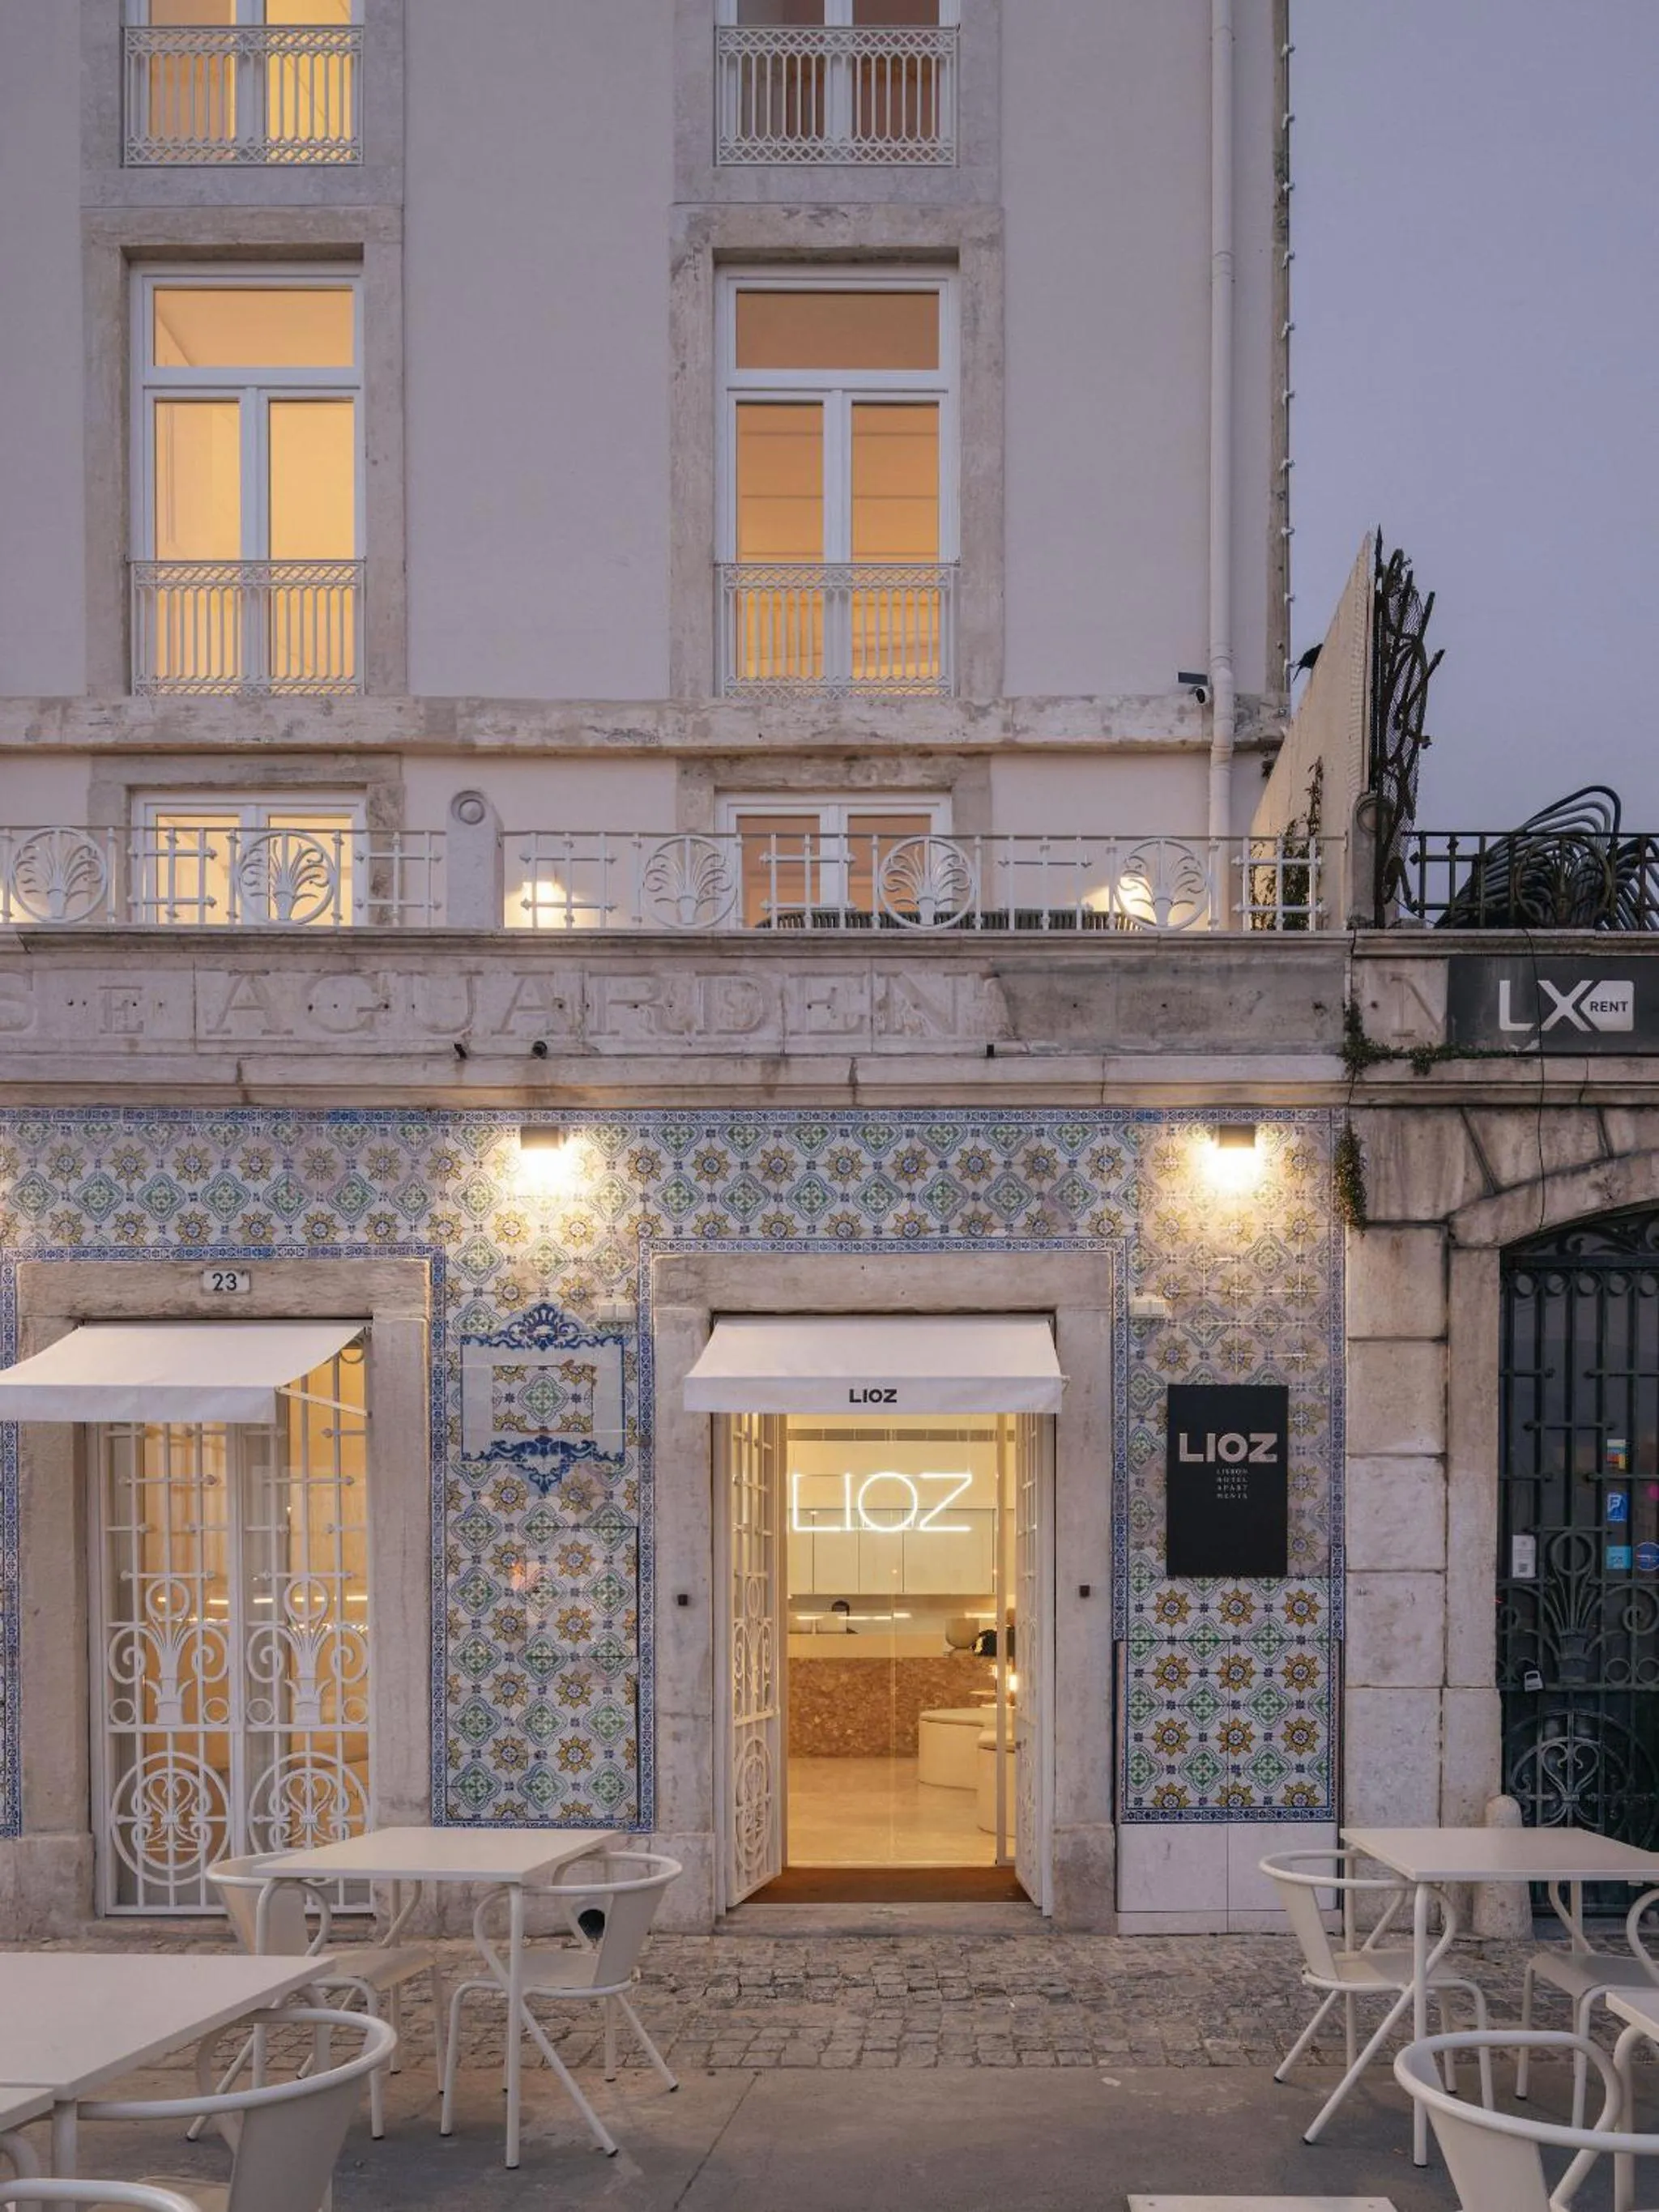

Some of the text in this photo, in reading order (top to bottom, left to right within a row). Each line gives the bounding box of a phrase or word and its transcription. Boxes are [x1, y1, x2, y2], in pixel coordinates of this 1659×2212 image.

[205, 970, 1001, 1036] AGUARDEN
[1499, 979, 1629, 1032] LX RENT
[211, 1272, 237, 1291] 23
[848, 1388, 898, 1404] LIOZ
[1179, 1432, 1278, 1463] LIOZ
[791, 1471, 973, 1532] LIOZ
